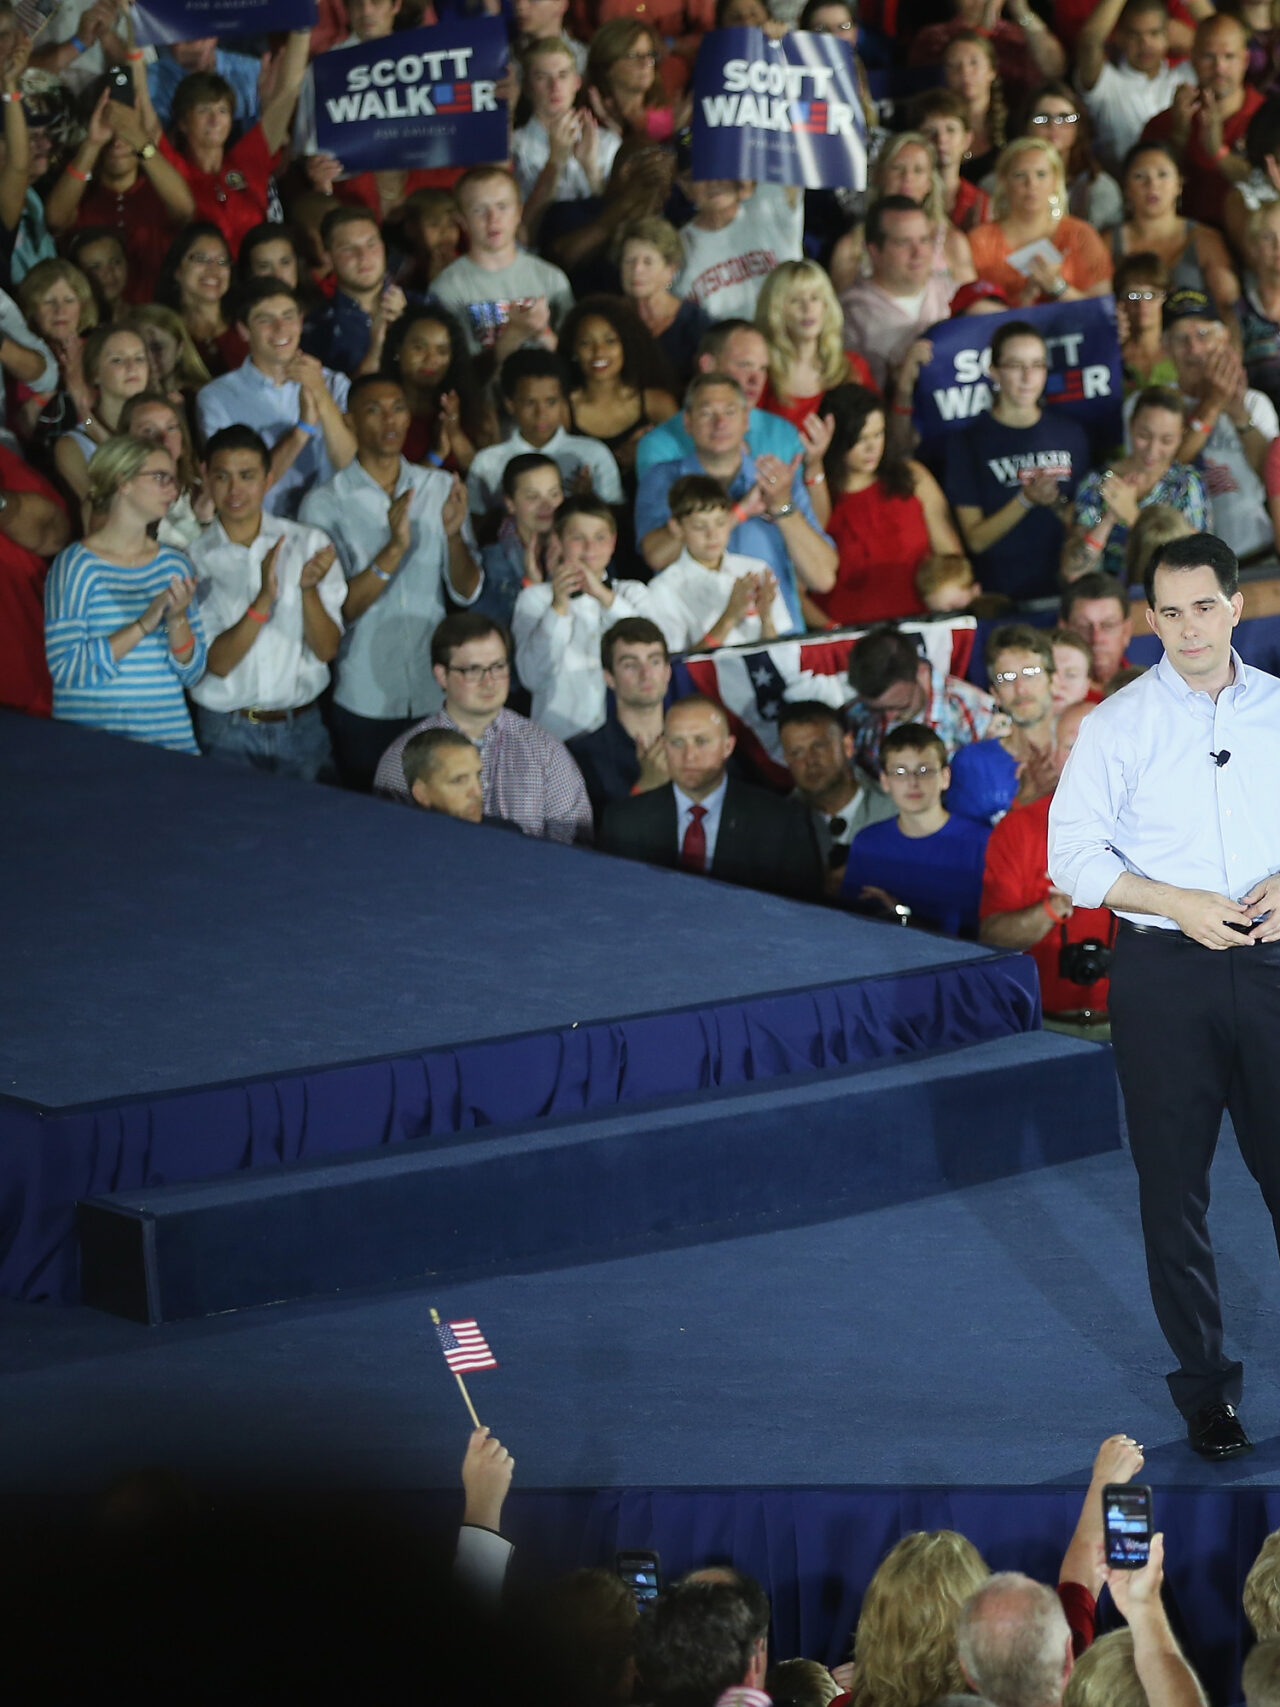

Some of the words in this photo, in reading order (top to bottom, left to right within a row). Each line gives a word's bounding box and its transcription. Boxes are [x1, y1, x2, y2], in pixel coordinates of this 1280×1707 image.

[346, 47, 473, 92] SCOTT
[722, 59, 833, 100] SCOTT
[326, 80, 498, 124] WALKER
[702, 94, 854, 135] WALKER
[953, 333, 1084, 384] SCTT
[933, 364, 1112, 422] WAER
